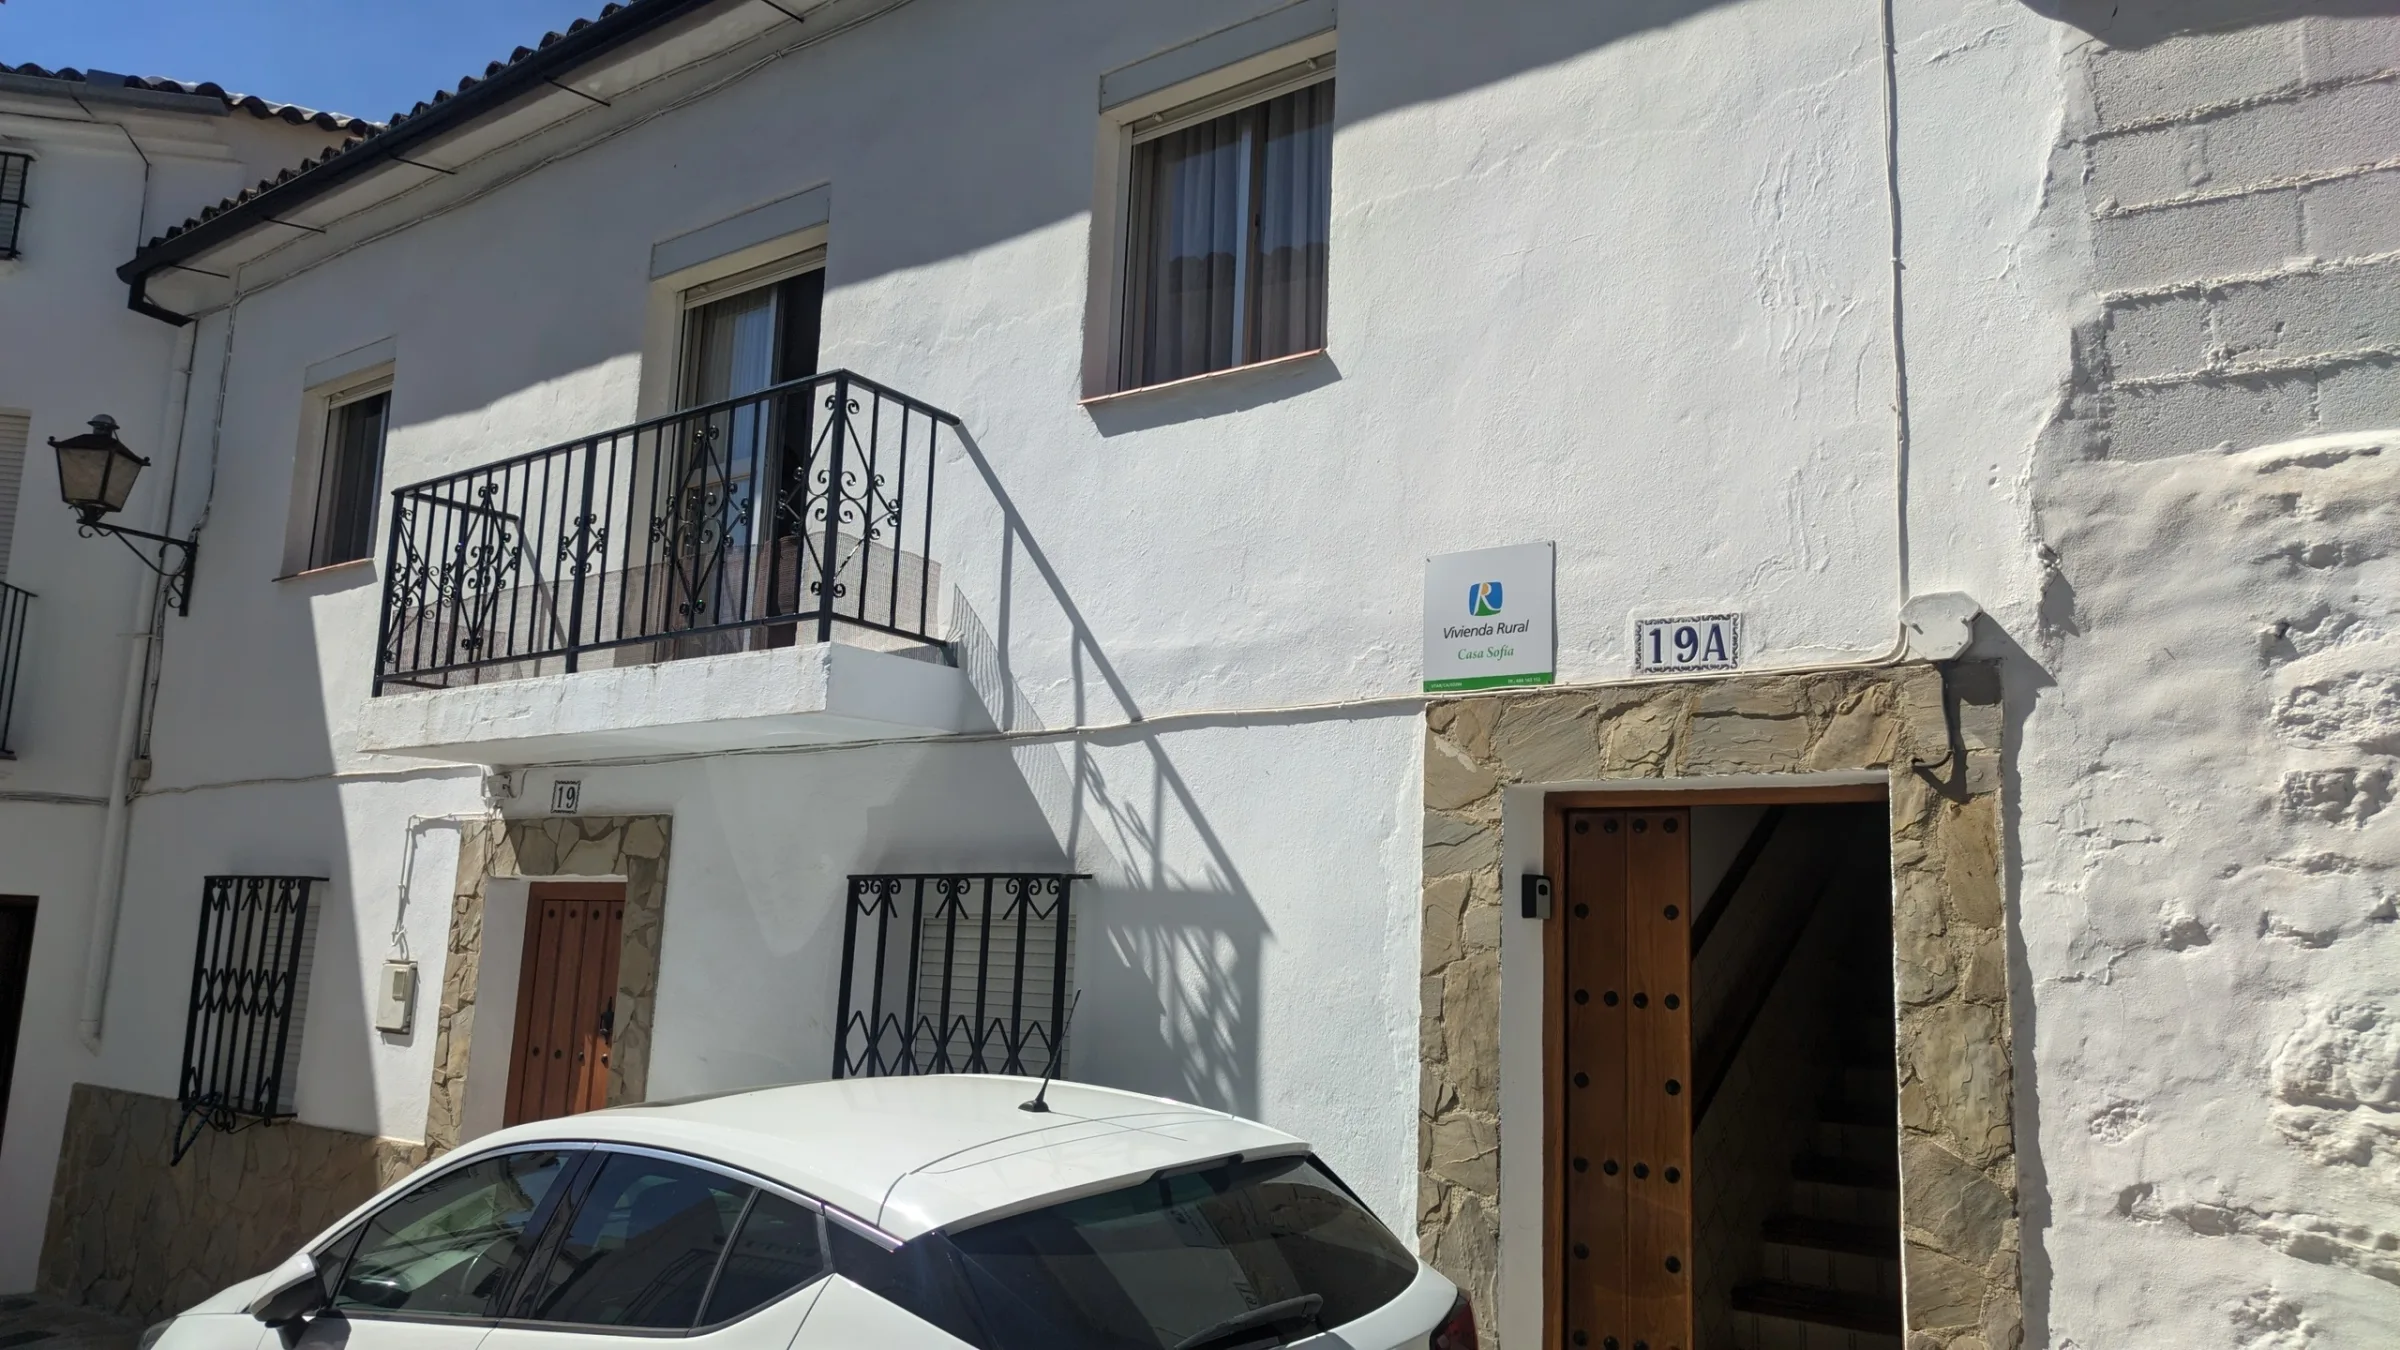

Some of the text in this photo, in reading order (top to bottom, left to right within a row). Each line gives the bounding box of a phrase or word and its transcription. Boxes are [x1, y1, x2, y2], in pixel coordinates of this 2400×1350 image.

[1443, 619, 1530, 639] Vivienda Rural
[1457, 644, 1514, 661] Casa Sofía
[1649, 623, 1728, 664] 19A
[557, 786, 576, 809] 19
